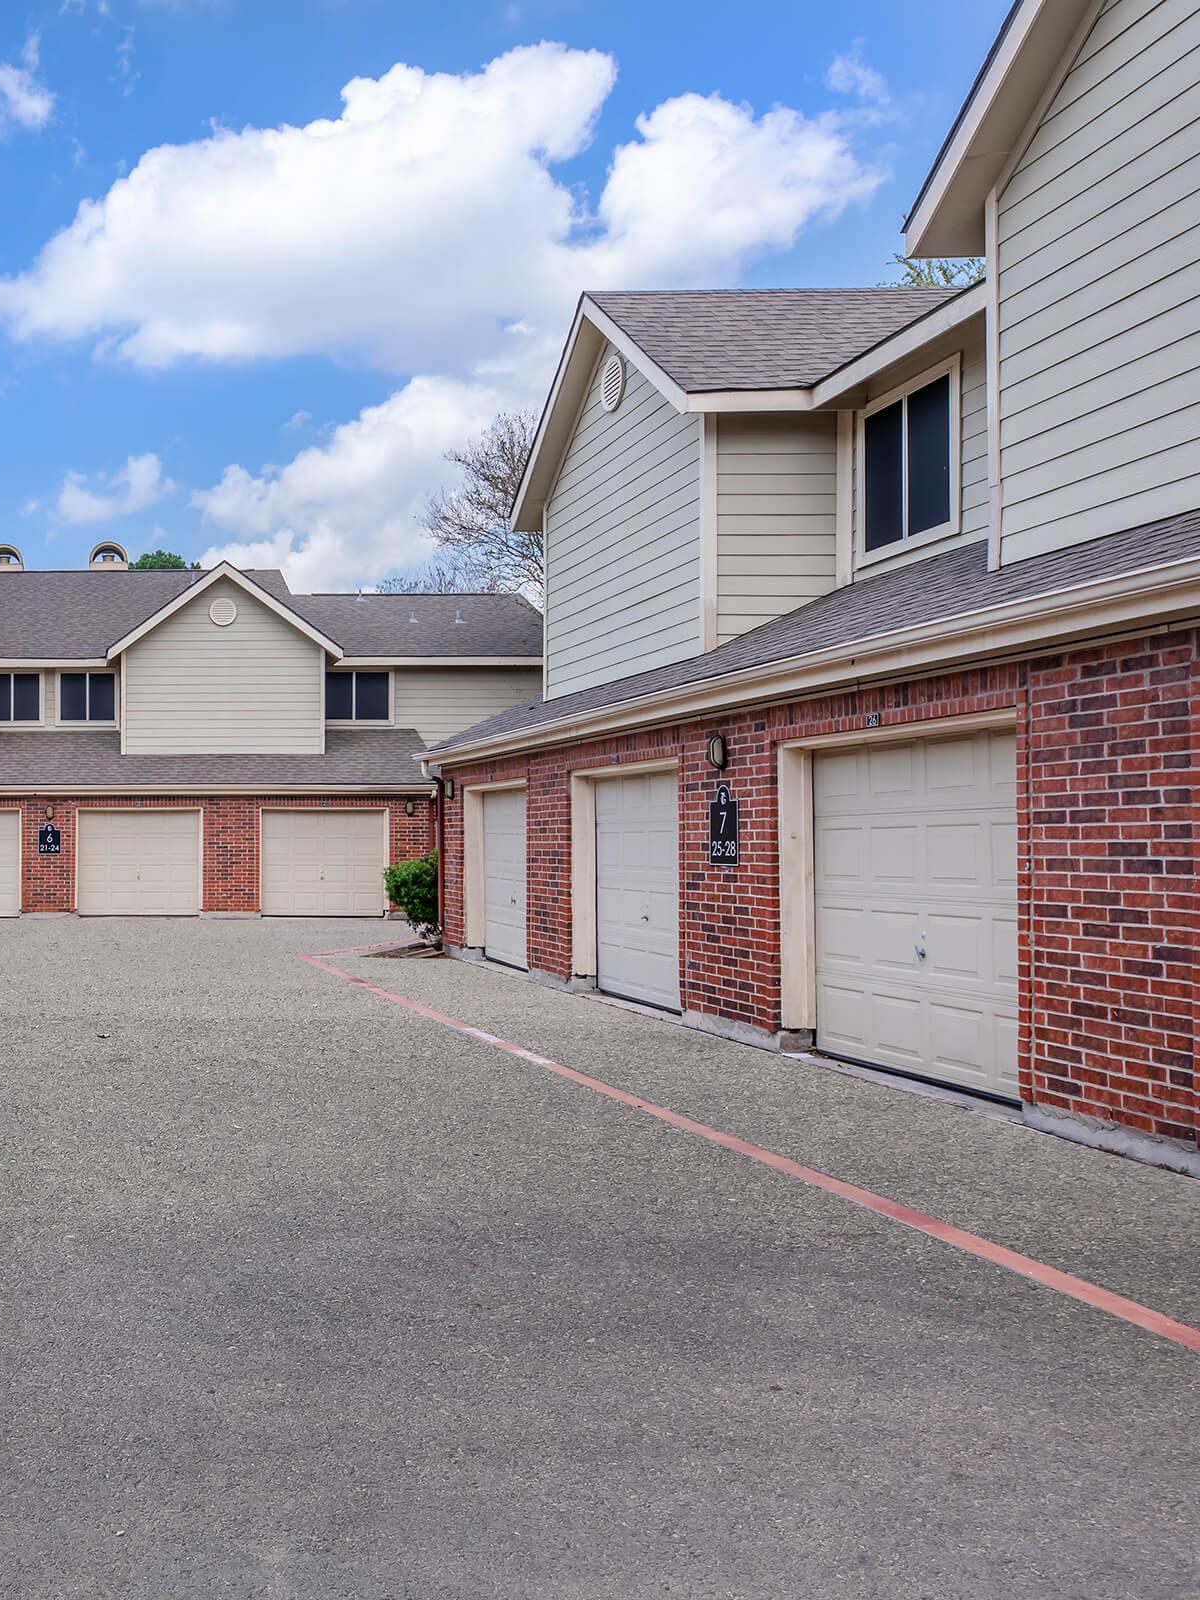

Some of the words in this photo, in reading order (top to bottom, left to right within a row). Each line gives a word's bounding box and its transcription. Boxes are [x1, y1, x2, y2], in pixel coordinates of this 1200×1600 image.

[720, 812, 727, 834] 7
[46, 833, 52, 843] 6
[40, 844, 59, 852] 21-24
[712, 840, 736, 857] 25-28
